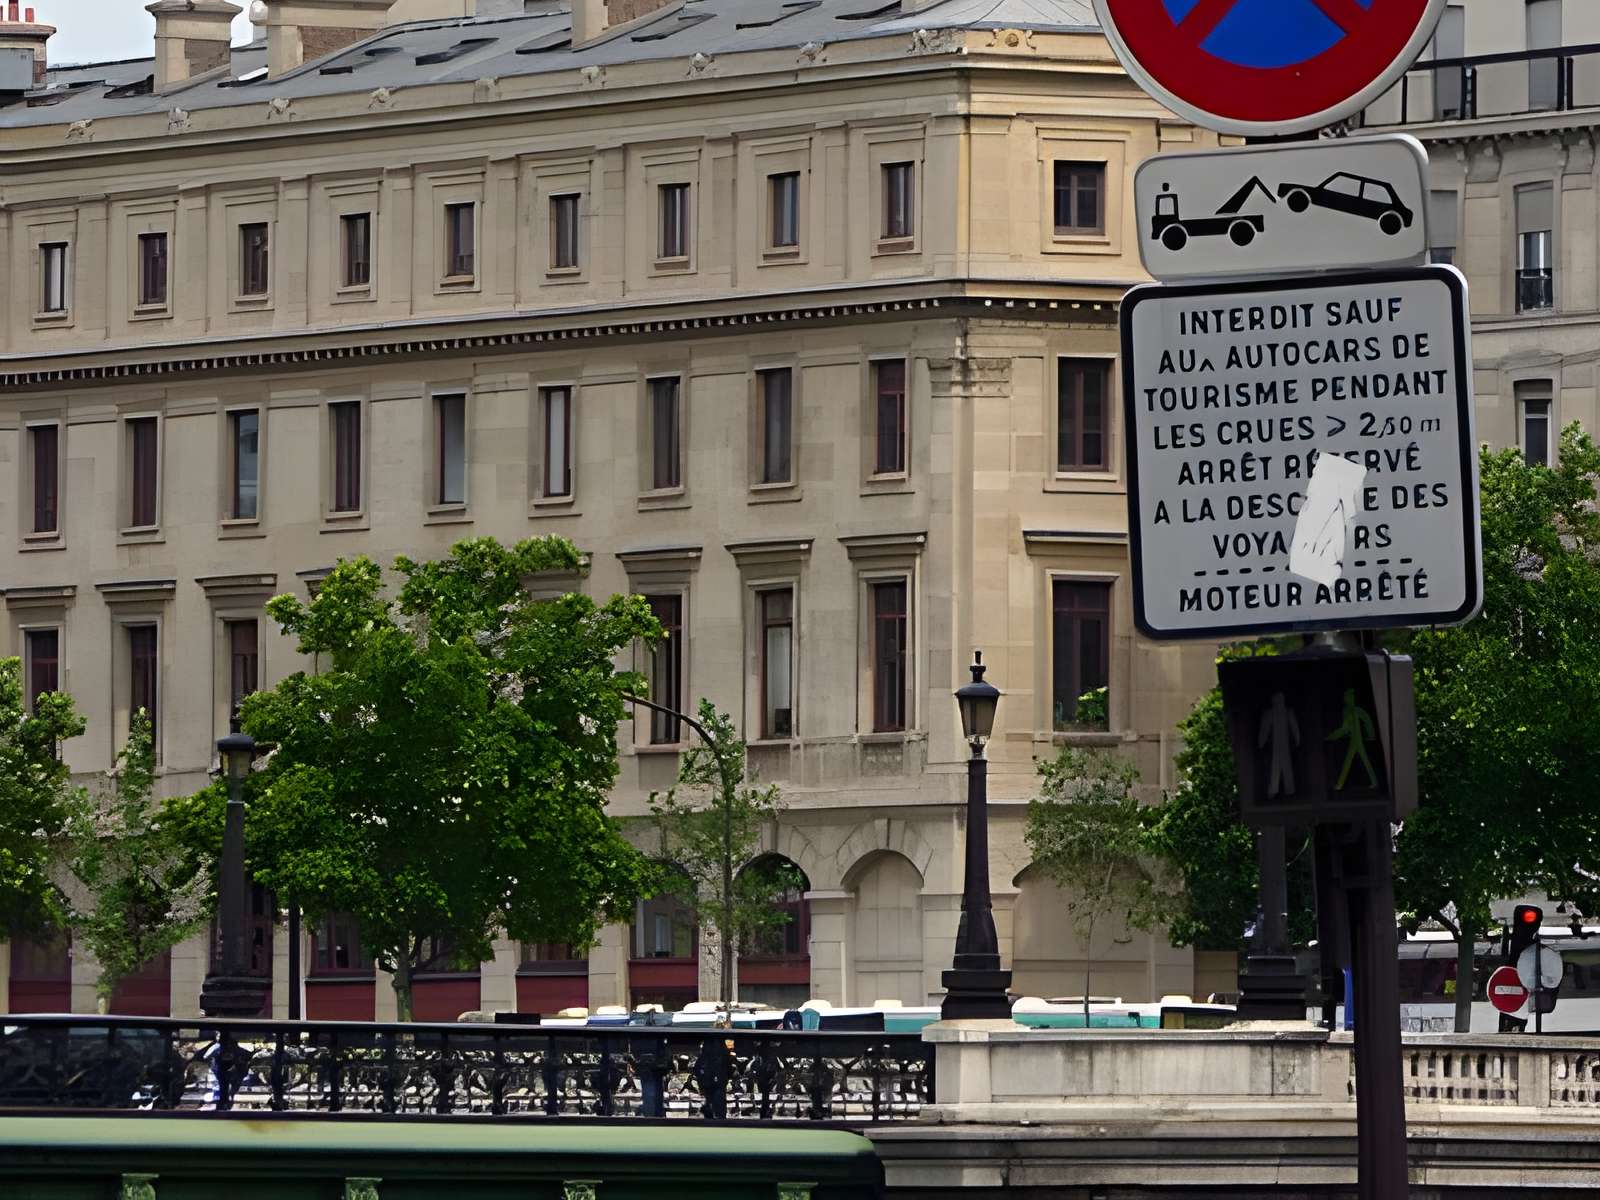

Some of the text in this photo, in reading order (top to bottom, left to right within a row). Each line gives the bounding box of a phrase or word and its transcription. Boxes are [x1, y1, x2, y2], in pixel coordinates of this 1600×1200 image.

[1179, 297, 1403, 335] INTERDIT SAUF
[1225, 336, 1381, 369] AUTOCARS
[1392, 333, 1430, 359] DE
[1143, 370, 1448, 412] TOURISME PENDANT
[1153, 423, 1206, 450] LES
[1216, 416, 1315, 443] CRUES
[1177, 442, 1422, 485] ARRÊT RÉRVÉ
[1153, 483, 1449, 525] A LA DESCE DES
[1212, 524, 1392, 558] VOYARS
[1179, 568, 1429, 612] MOTEUR ARRÊTÉ
